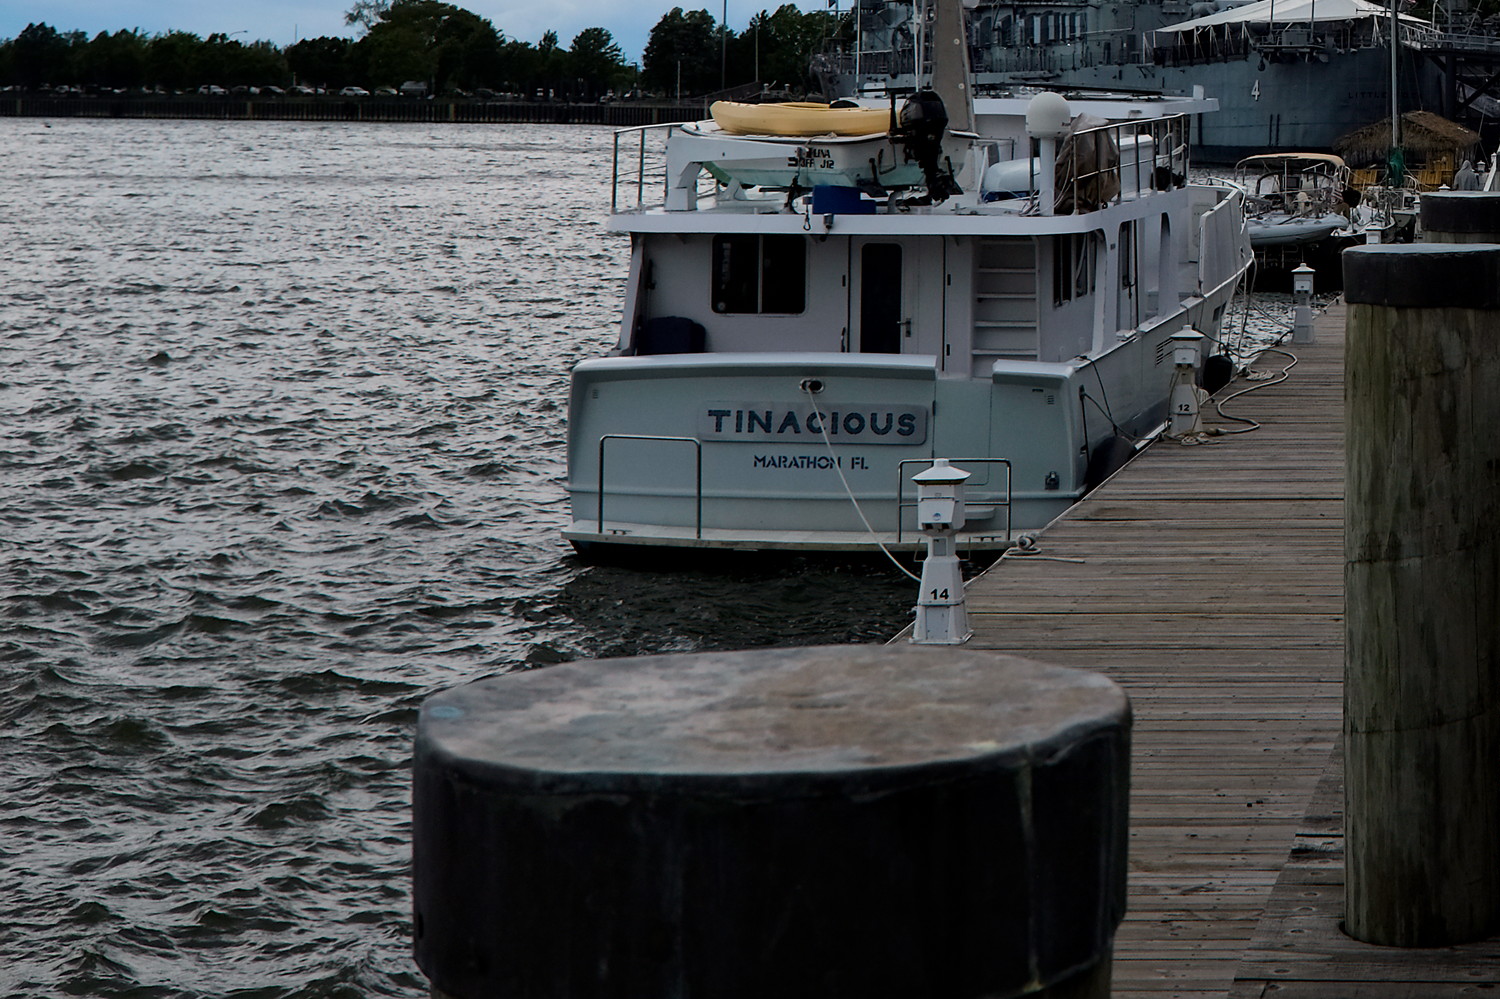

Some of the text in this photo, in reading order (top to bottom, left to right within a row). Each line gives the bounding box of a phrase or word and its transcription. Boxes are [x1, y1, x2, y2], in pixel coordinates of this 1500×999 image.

[1250, 79, 1261, 102] 4
[1177, 403, 1190, 412] 12
[708, 409, 917, 437] TINACIOUS
[754, 455, 869, 470] MARATHON FL
[930, 588, 949, 600] 14
